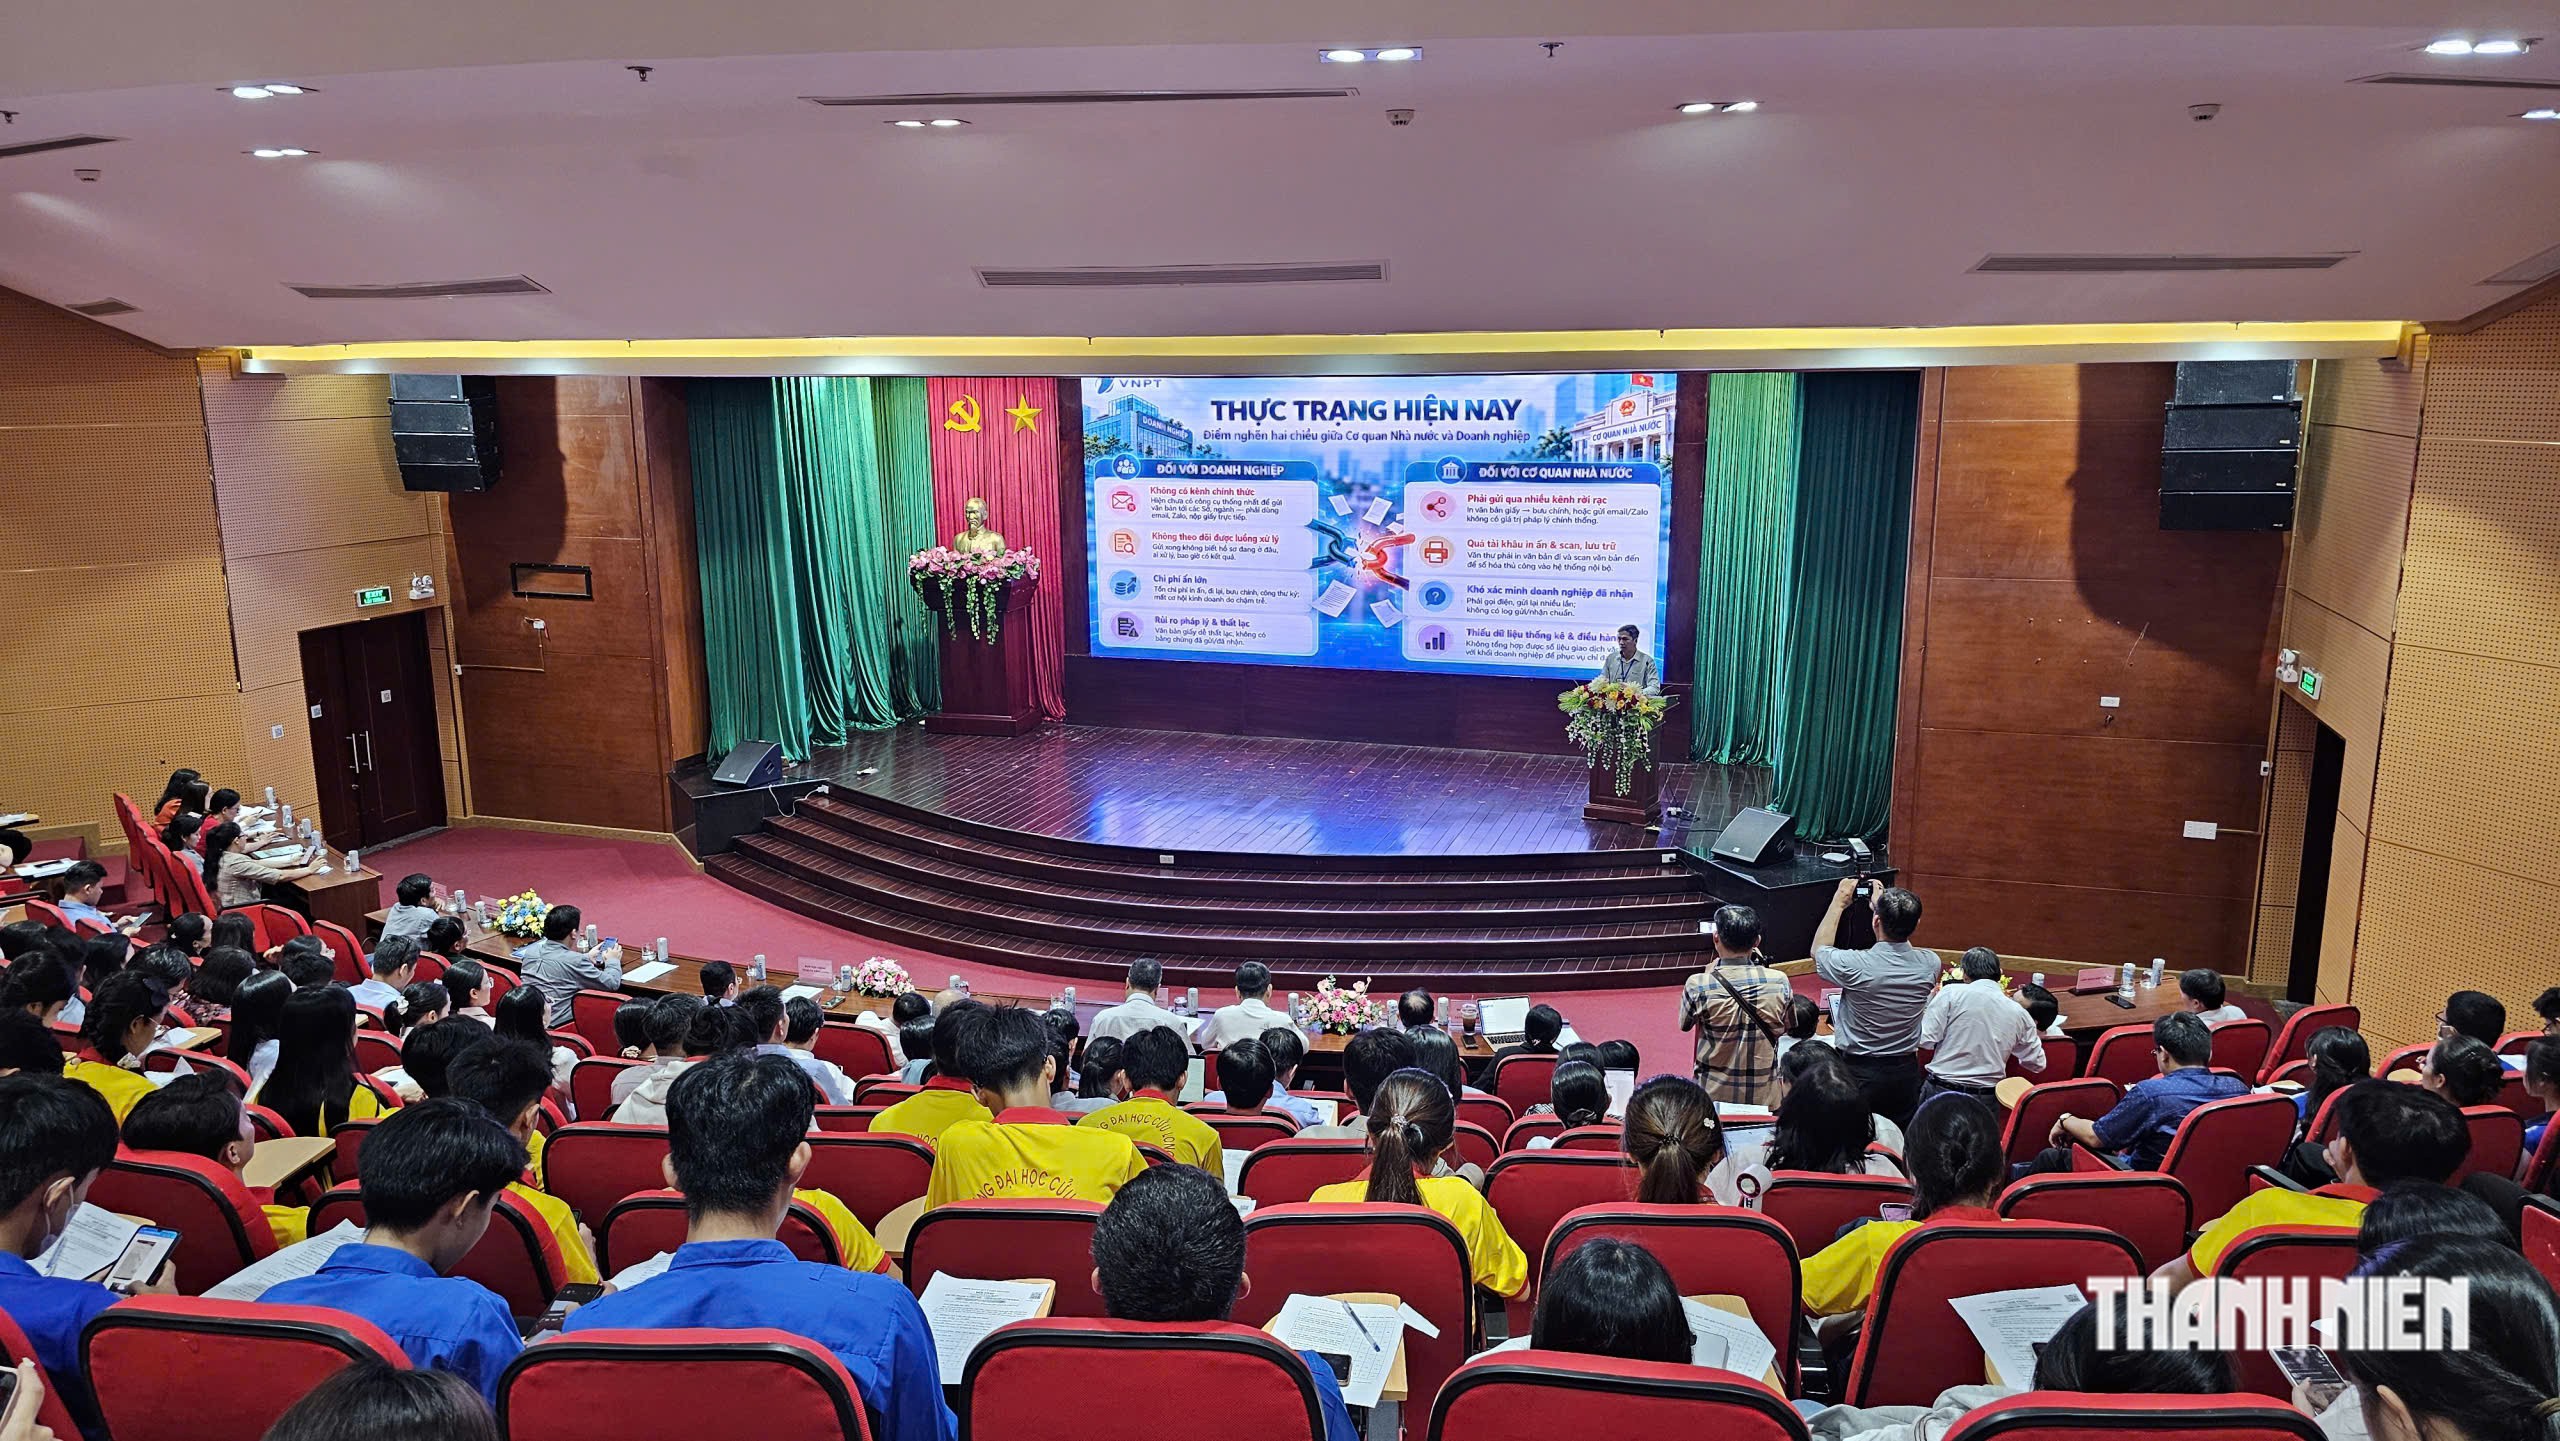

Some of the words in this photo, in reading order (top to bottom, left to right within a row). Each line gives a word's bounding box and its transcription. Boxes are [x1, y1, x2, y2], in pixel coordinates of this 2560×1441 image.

[1119, 379, 1162, 388] VNPT
[1211, 398, 1287, 426] THỰC
[1293, 400, 1387, 426] TRẠNG
[1394, 394, 1458, 426] HIỆN
[1465, 399, 1522, 421] NAY
[1203, 430, 1231, 440] Điểm
[1271, 431, 1287, 440] hai
[1290, 430, 1318, 440] chiều
[1320, 431, 1343, 442] giữa
[1346, 431, 1359, 440] Cơ
[1362, 434, 1387, 442] quan
[1390, 431, 1411, 440] Nhà
[1414, 431, 1438, 441] nước
[1442, 431, 1454, 441] và
[1456, 432, 1490, 441] Doanh
[1492, 431, 1530, 443] nghiệp
[1602, 429, 1621, 441] QUAN
[1157, 462, 1176, 474] ĐỐI
[1179, 463, 1198, 474] VỚI
[1201, 466, 1241, 475] DOANH
[1244, 464, 1284, 477] NGHIỆP
[1479, 466, 1498, 478] ĐỐI
[1501, 467, 1520, 478] VỚI
[1522, 468, 1537, 478] CƠ
[1539, 469, 1571, 479] QUAN
[1573, 467, 1597, 478] NHÀ
[1600, 467, 1632, 478] NƯỚC
[1150, 487, 1177, 496] Không
[1178, 487, 1188, 495] có
[1467, 495, 1487, 503] Phải
[1489, 495, 1504, 505] gửi
[1505, 497, 1522, 505] qua
[1552, 495, 1575, 504] kênh
[1577, 495, 1590, 504] rời
[1593, 498, 1607, 506] rạc
[1152, 532, 1177, 542] Không
[1179, 533, 1197, 541] theo
[1467, 540, 1485, 549] Quá
[1487, 540, 1499, 548] tải
[1525, 541, 1534, 549] in
[1550, 541, 1557, 549] &
[1585, 542, 1600, 550] lưu
[1168, 575, 1181, 584] phí
[1467, 585, 1485, 594] Khó
[1487, 585, 1502, 594] xác
[1504, 586, 1528, 595] minh
[1530, 587, 1559, 596] doanh
[1561, 587, 1593, 598] nghiệp
[1610, 588, 1633, 599] nhận
[1501, 608, 1513, 616] log
[1180, 617, 1200, 627] pháp
[1467, 628, 1491, 637] Thiếu
[1506, 630, 1523, 640] liệu
[1554, 631, 1565, 640] kê
[1568, 632, 1574, 640] &
[1599, 632, 1618, 642] hàn
[1110, 1114, 1128, 1125] ĐẠI
[1130, 1113, 1152, 1124] HỌC
[994, 1169, 1017, 1189] ĐẠI
[1021, 1168, 1048, 1188] HỌC
